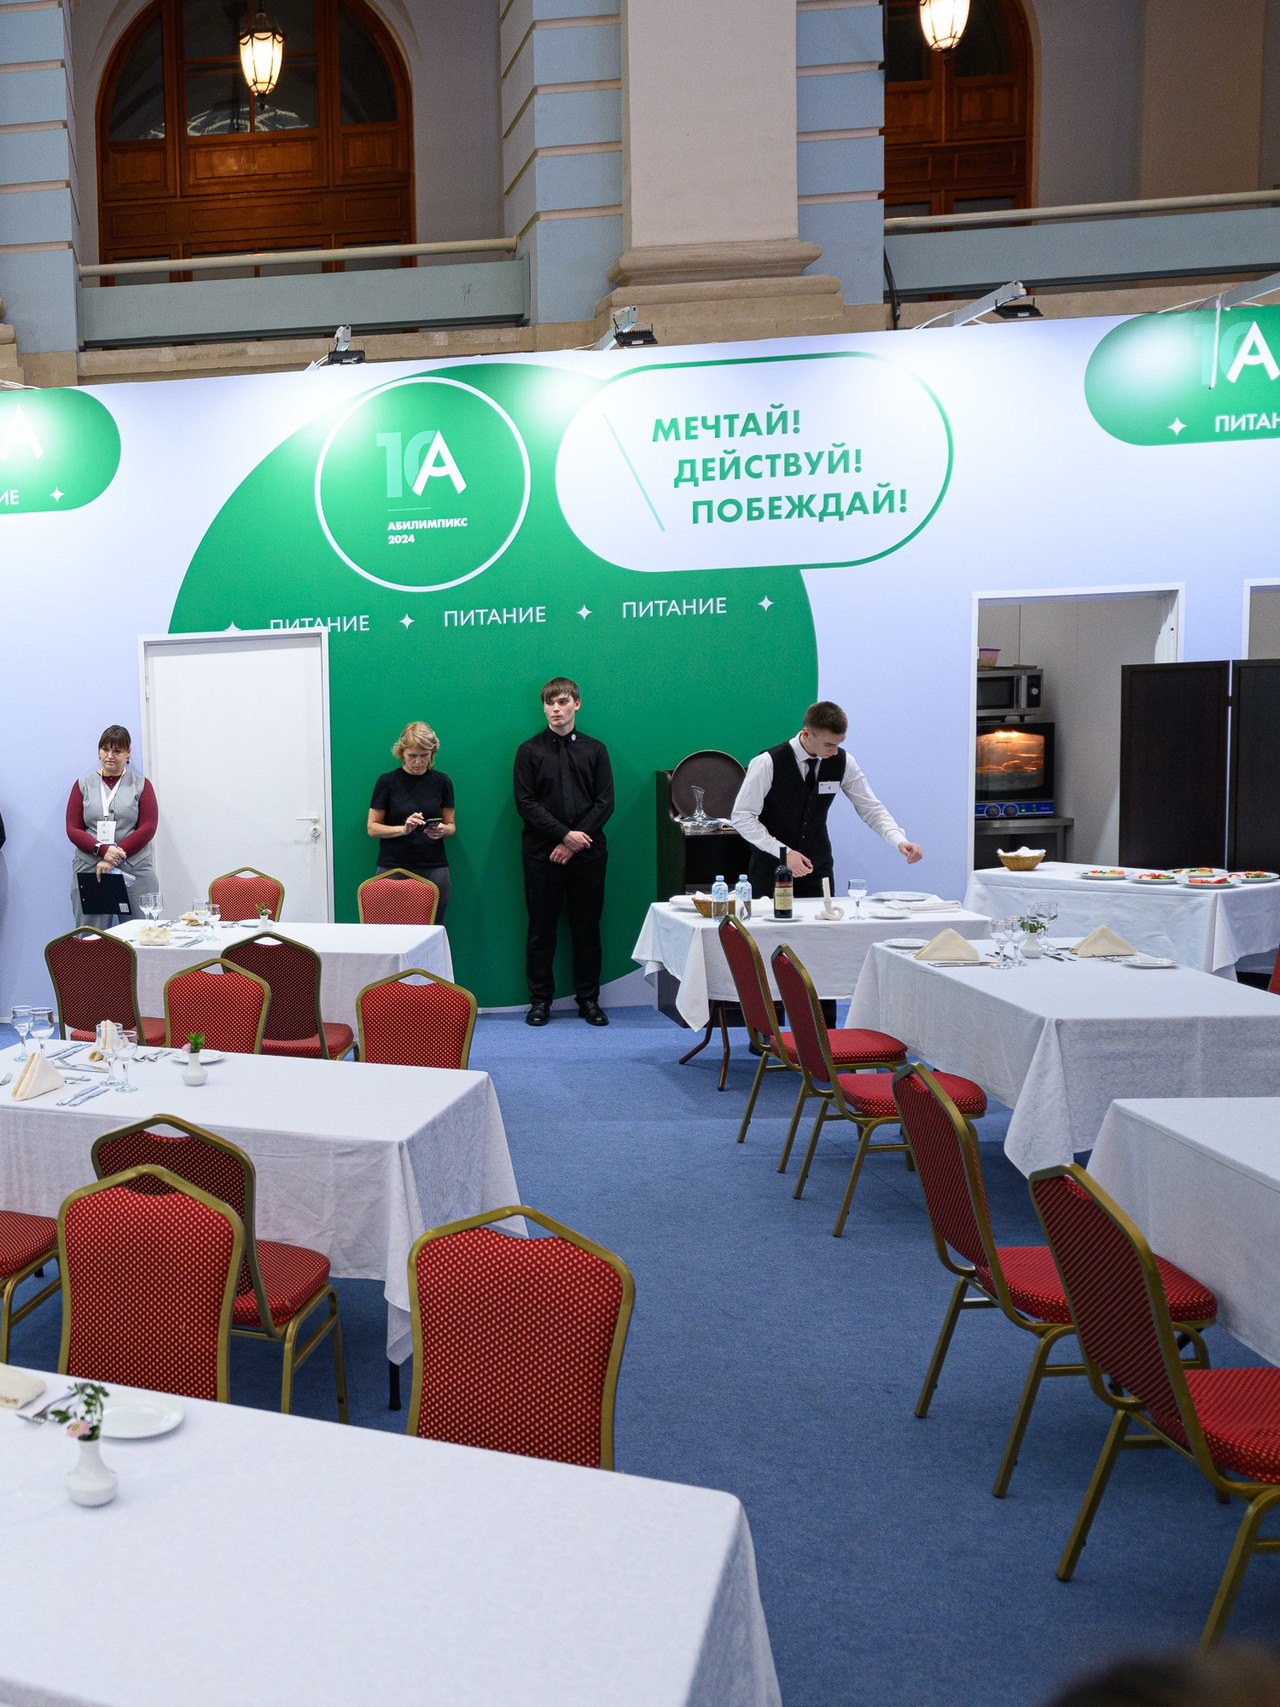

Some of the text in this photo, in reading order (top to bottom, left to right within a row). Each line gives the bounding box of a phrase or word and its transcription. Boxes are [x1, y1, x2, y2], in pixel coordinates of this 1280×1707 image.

[651, 403, 801, 443] МЕЧТАЙ!
[673, 443, 863, 488] ДЕЙСТВУЙ!
[691, 482, 909, 525] ПОБЕЖДАЙ!
[387, 517, 468, 531] АБИЛИМПИКС
[388, 534, 415, 545] 2024
[443, 606, 546, 627] ПИТАНИЕ
[622, 597, 727, 619] ПИТАНИЕ
